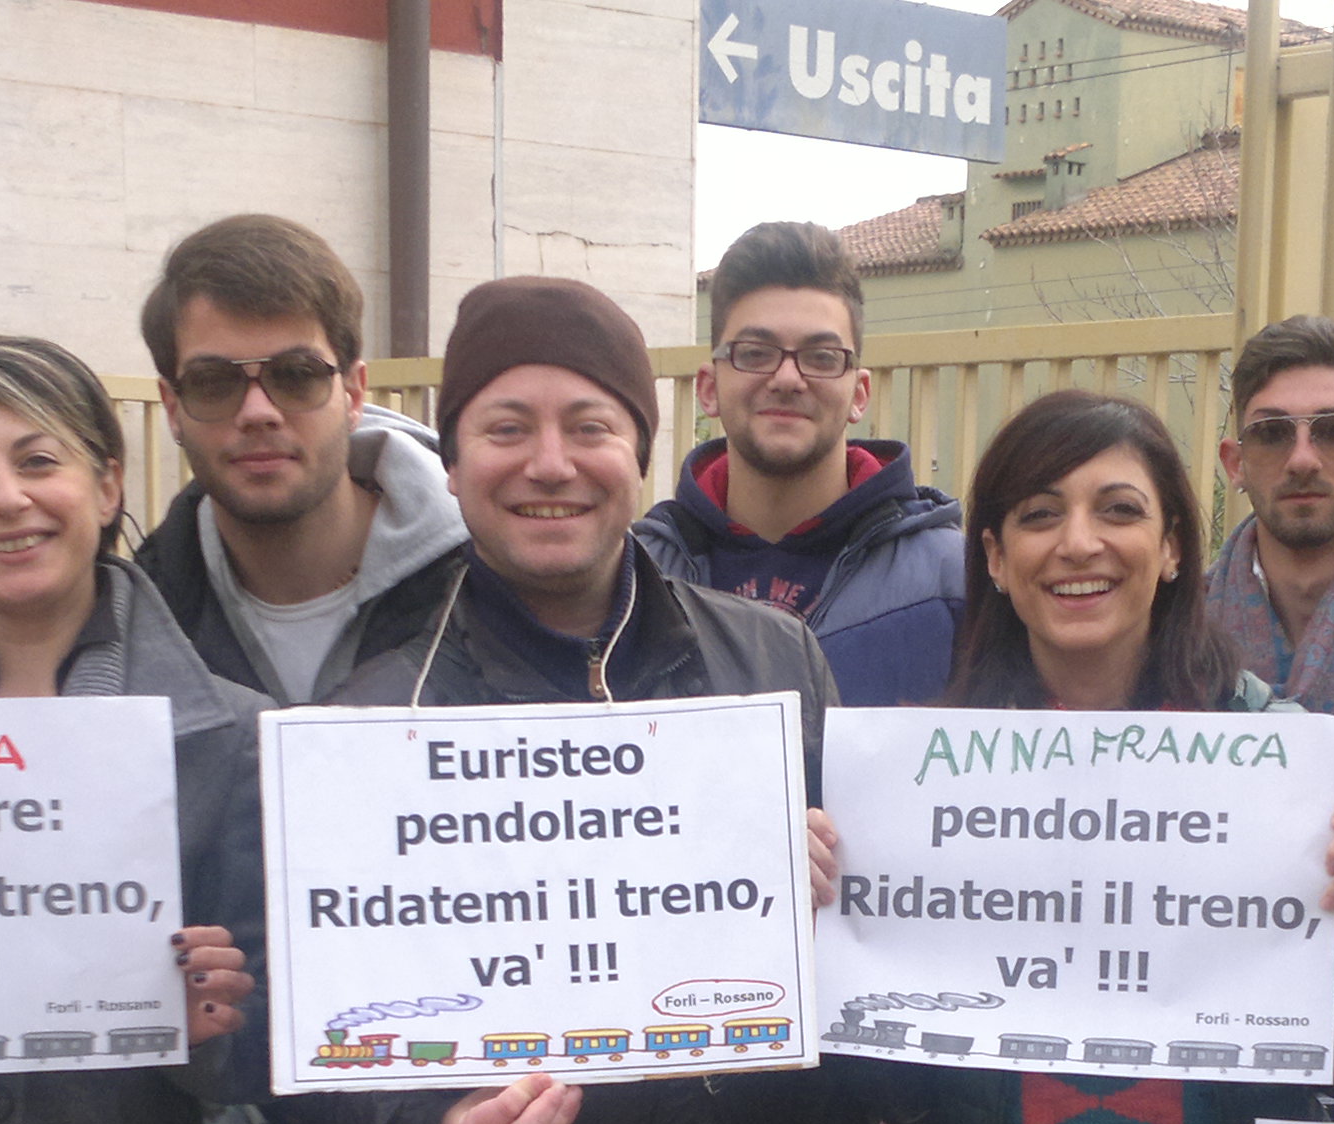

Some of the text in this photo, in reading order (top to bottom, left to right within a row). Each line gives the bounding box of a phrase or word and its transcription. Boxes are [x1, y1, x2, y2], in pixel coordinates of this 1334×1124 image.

[788, 24, 992, 125] Uscita
[396, 799, 680, 855] pendolare:
[931, 797, 1229, 848] pendolare:
[308, 877, 775, 929] Ridatemi il treno,
[839, 875, 1324, 940] Ridatemi il treno,
[469, 942, 619, 987] va' !!!
[995, 946, 1150, 993] va' !!!
[97, 999, 163, 1012] Rossano
[713, 991, 775, 1005] Rossano
[1244, 1013, 1311, 1027] Rossano
